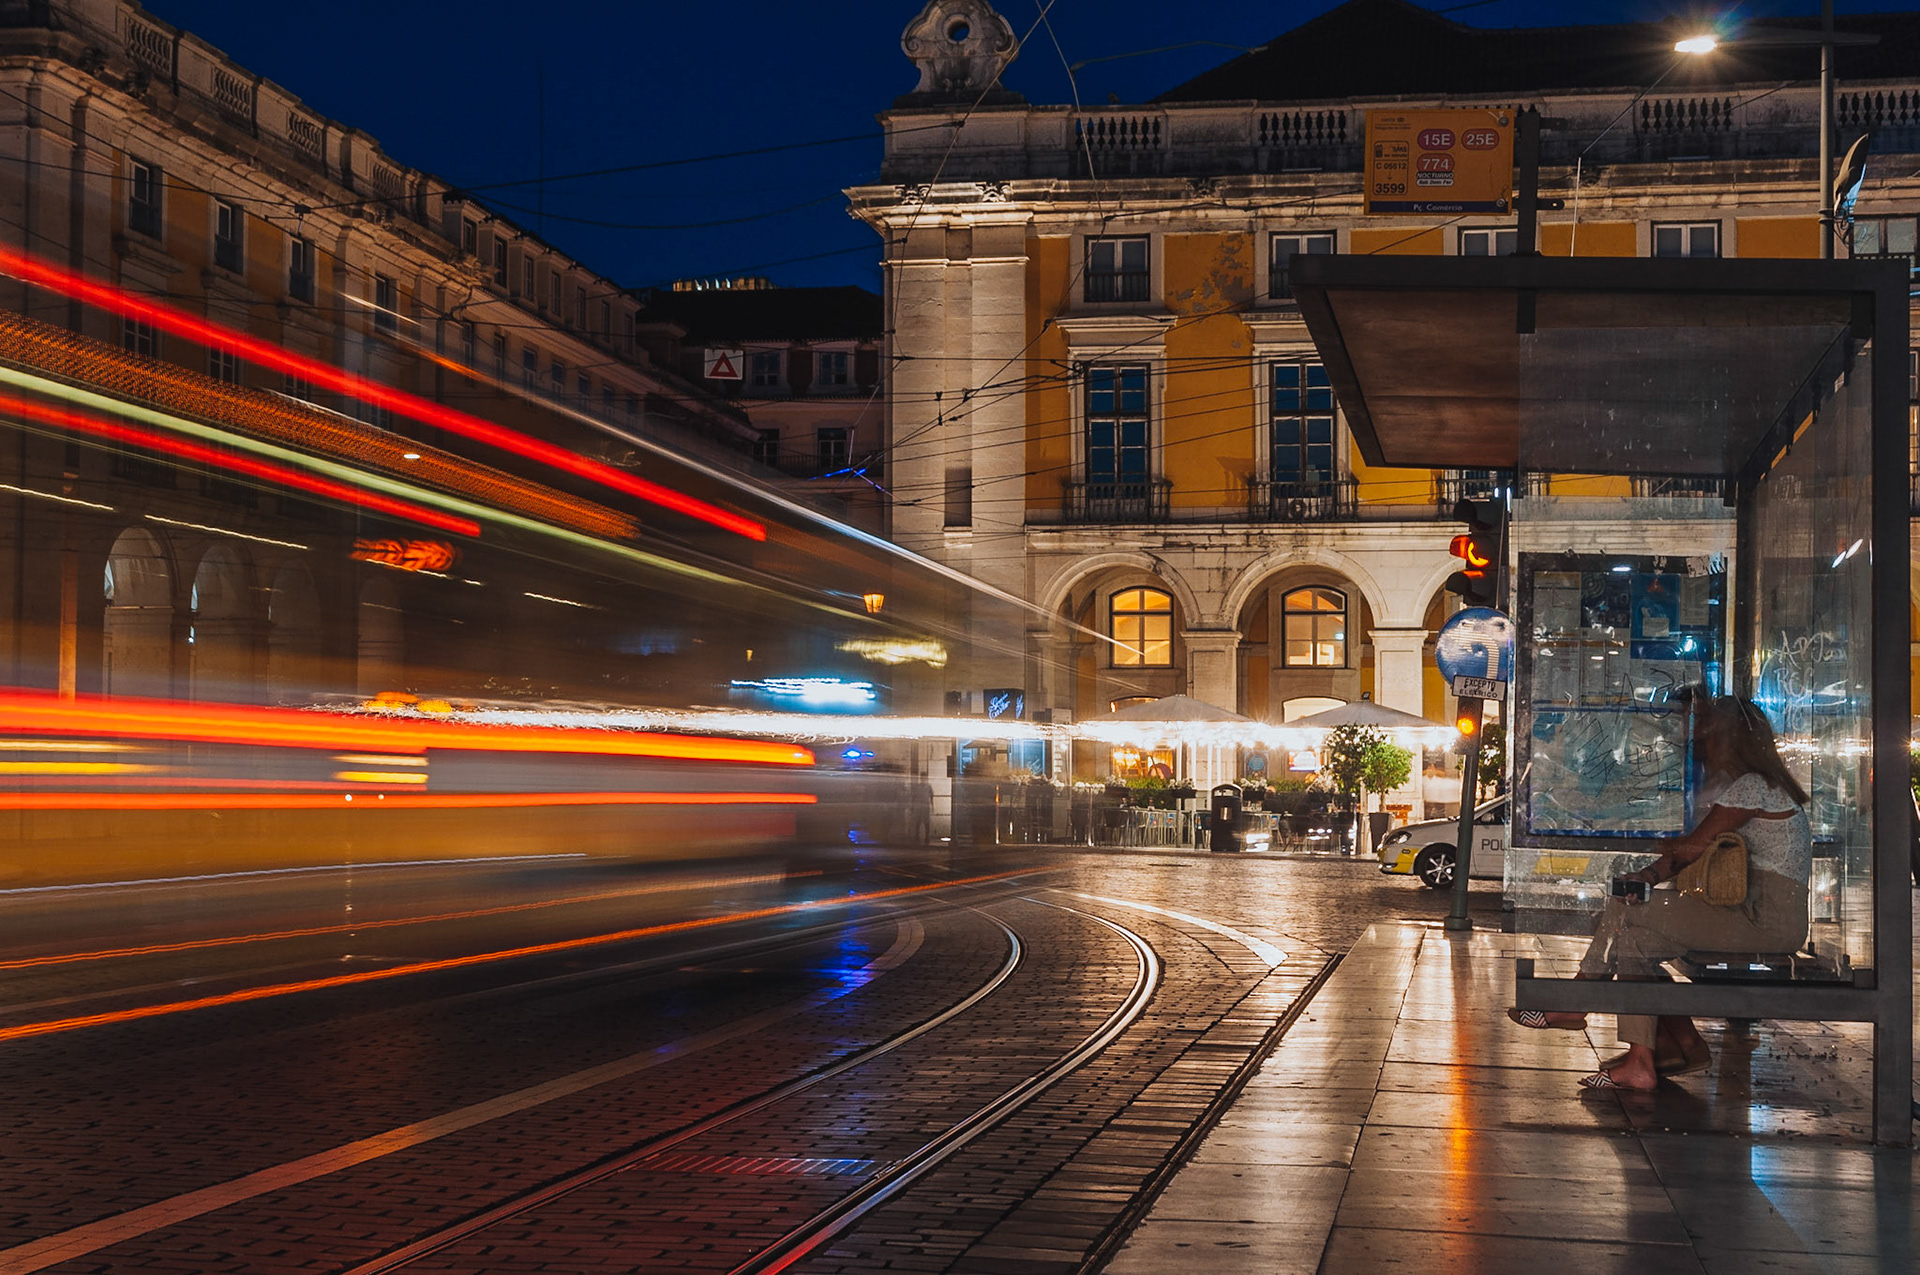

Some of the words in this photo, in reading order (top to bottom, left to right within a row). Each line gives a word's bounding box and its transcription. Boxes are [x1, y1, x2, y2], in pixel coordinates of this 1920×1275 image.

[1423, 133, 1451, 146] 15E
[1466, 133, 1495, 146] 25E
[1422, 158, 1449, 170] 774
[1375, 183, 1405, 194] 3599
[1464, 678, 1496, 690] EXCEPTO
